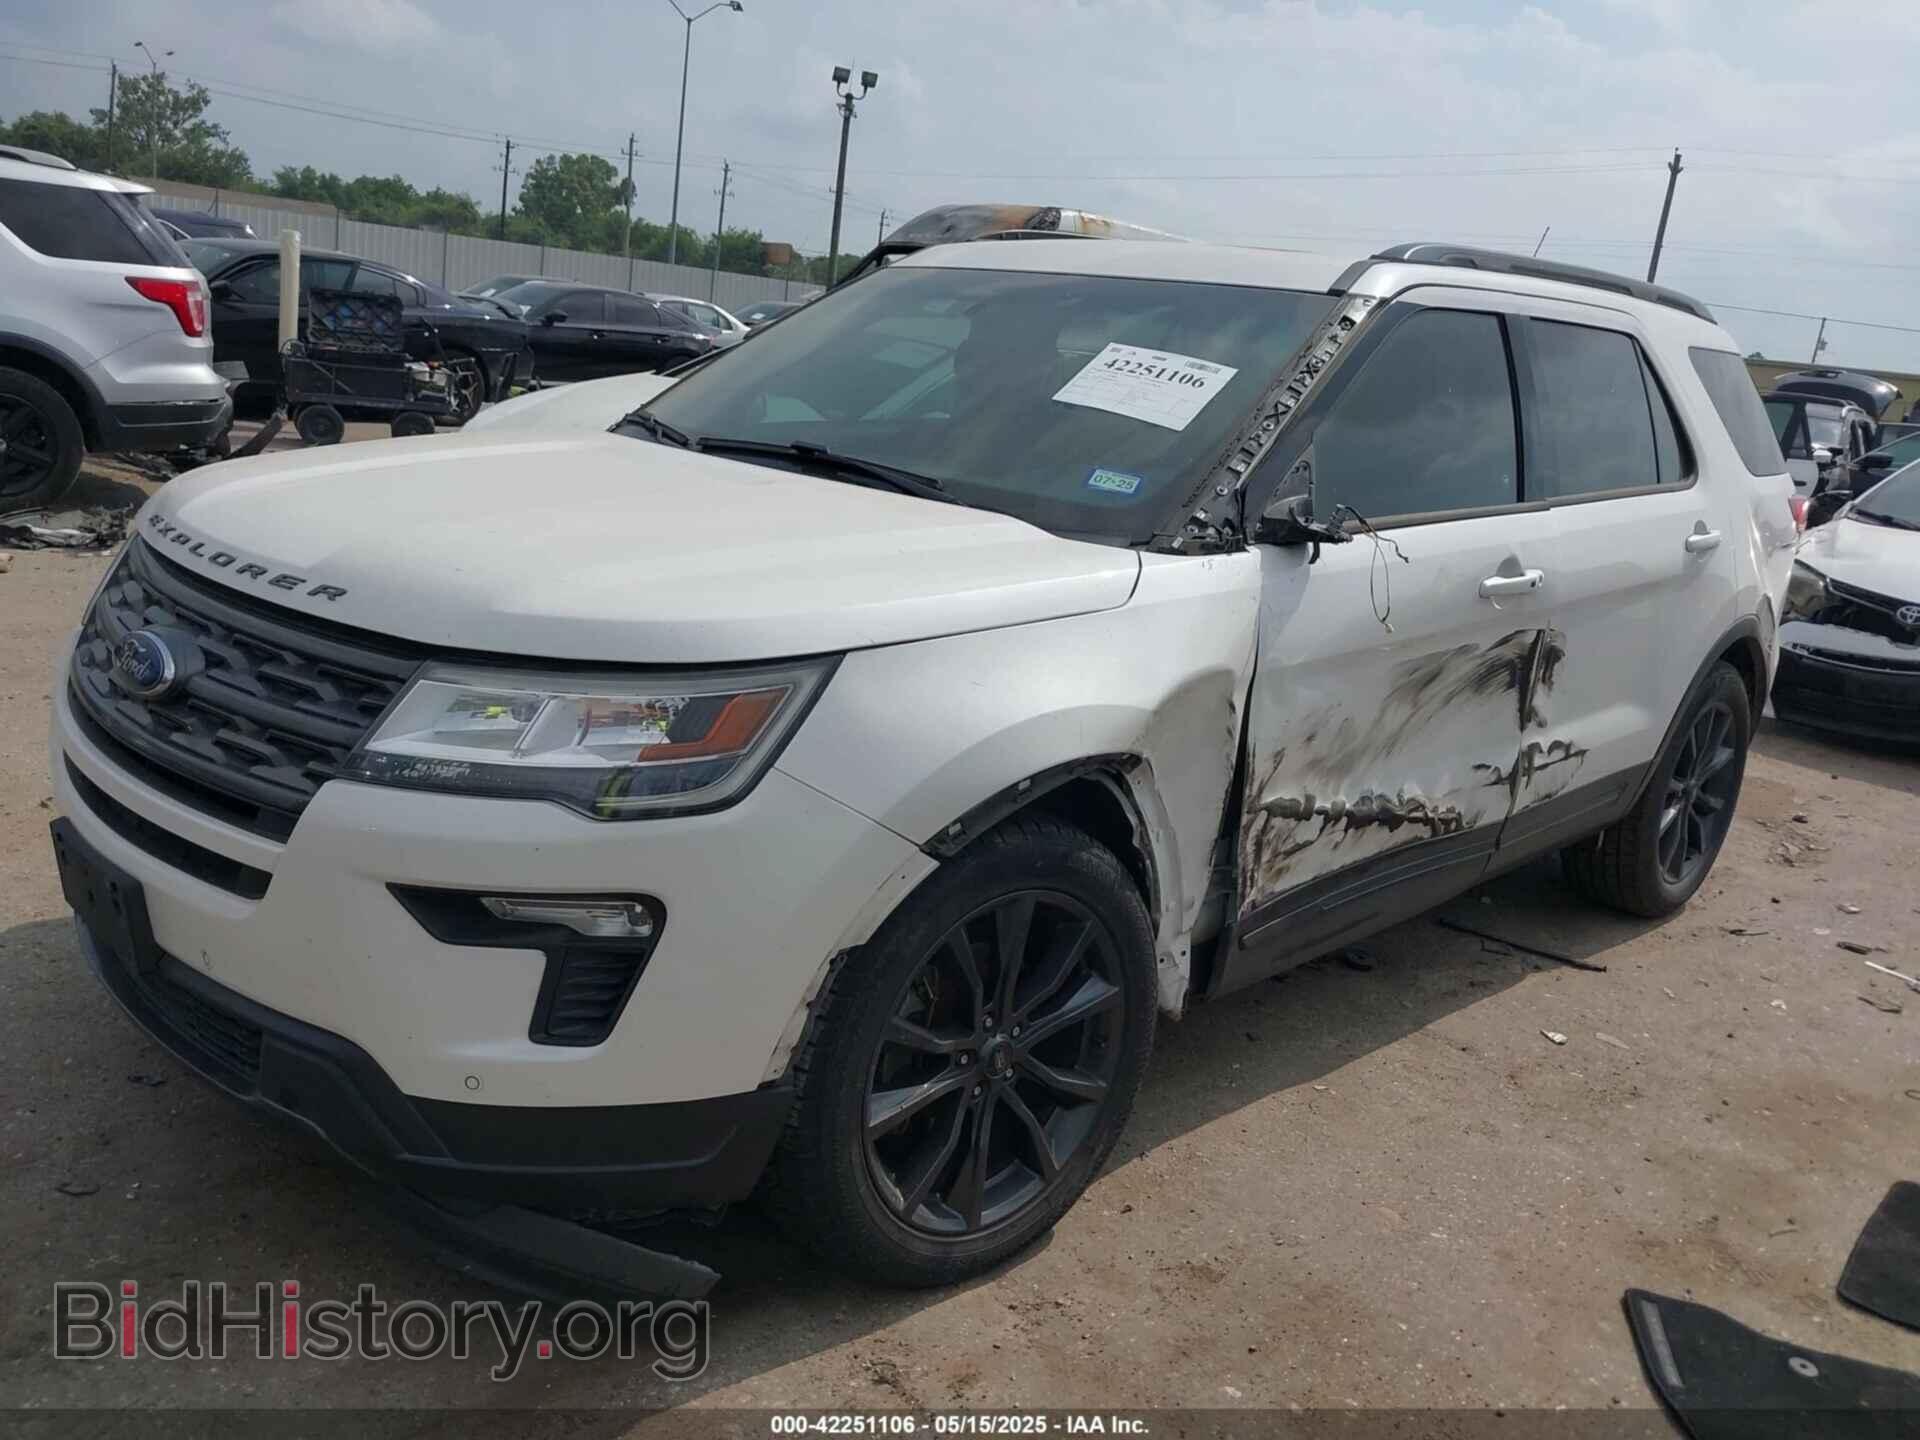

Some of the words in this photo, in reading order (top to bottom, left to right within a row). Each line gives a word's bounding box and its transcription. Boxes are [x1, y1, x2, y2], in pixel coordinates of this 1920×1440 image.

[1104, 358, 1206, 388] 42251106
[149, 514, 348, 601] EXPLORER
[116, 639, 151, 679] Ford
